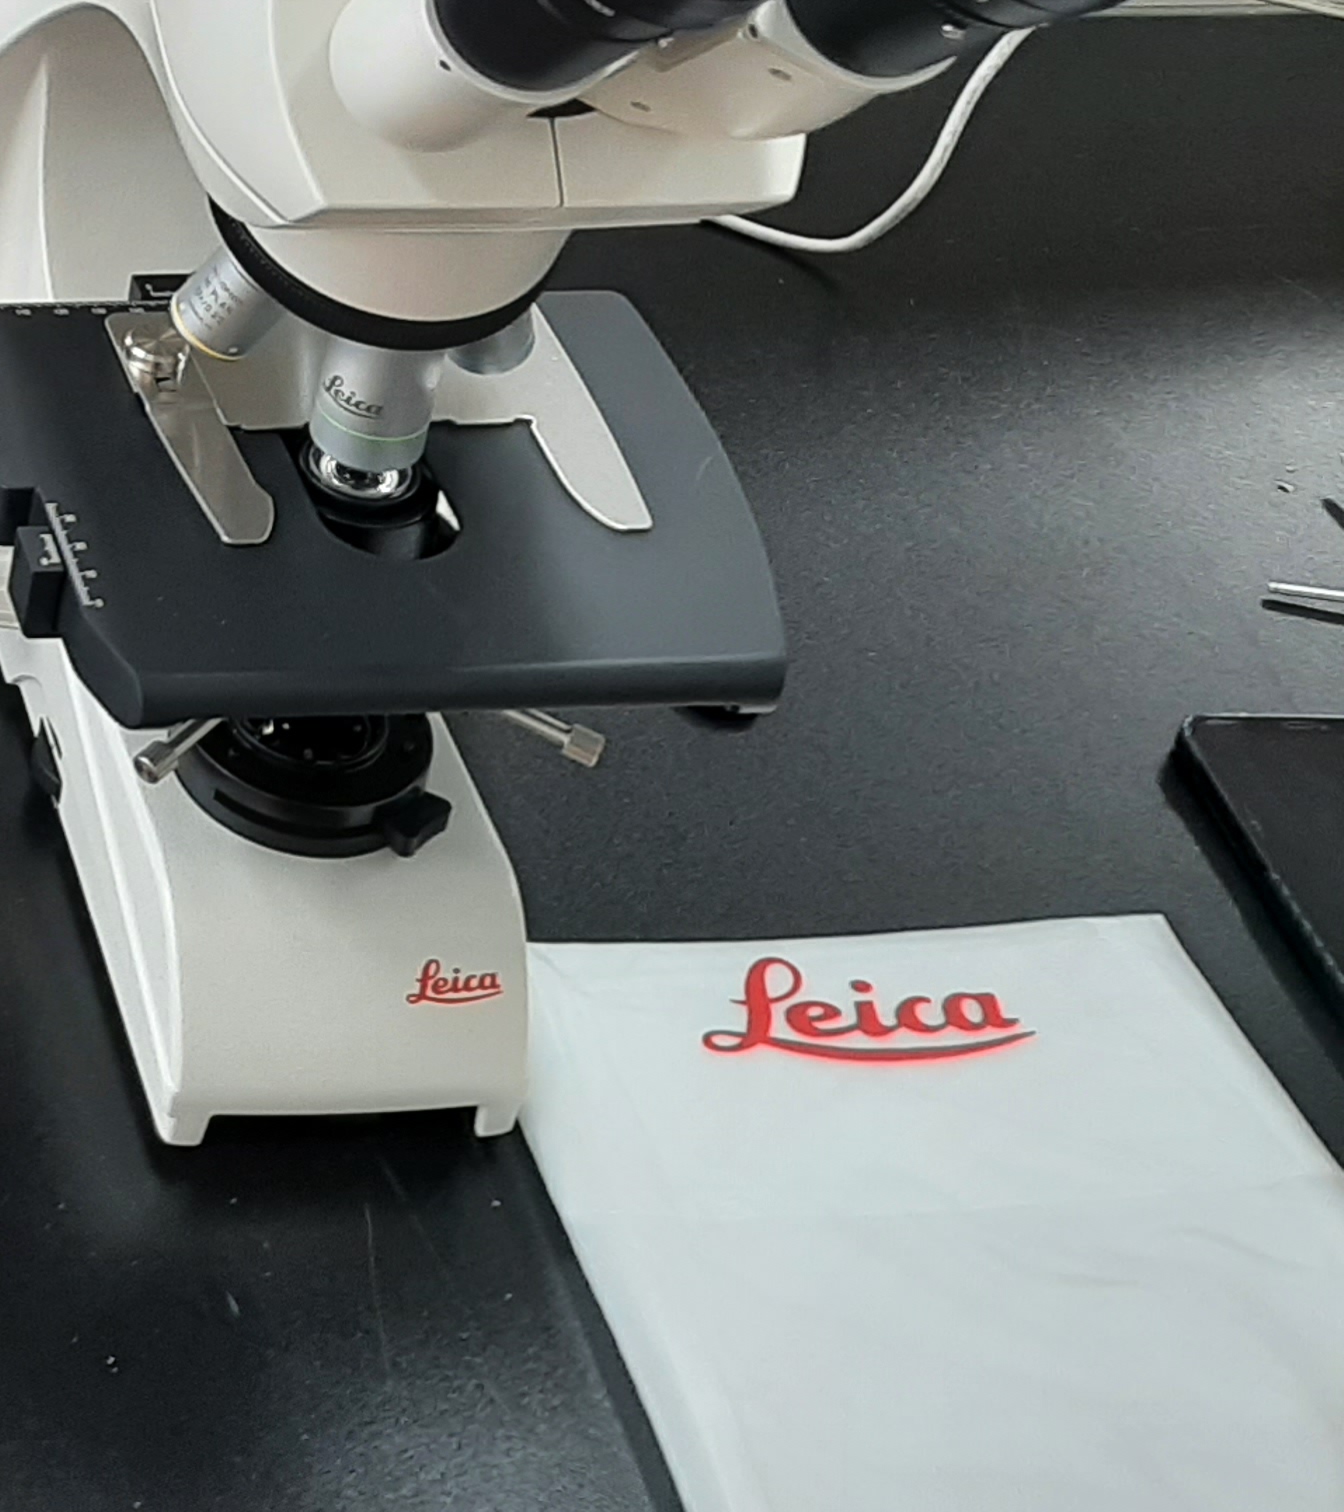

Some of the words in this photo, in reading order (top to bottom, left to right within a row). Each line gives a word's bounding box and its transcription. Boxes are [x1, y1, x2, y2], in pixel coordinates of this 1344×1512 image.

[323, 375, 383, 419] Leica
[407, 958, 503, 1004] Leica
[702, 957, 1036, 1062] Leica
